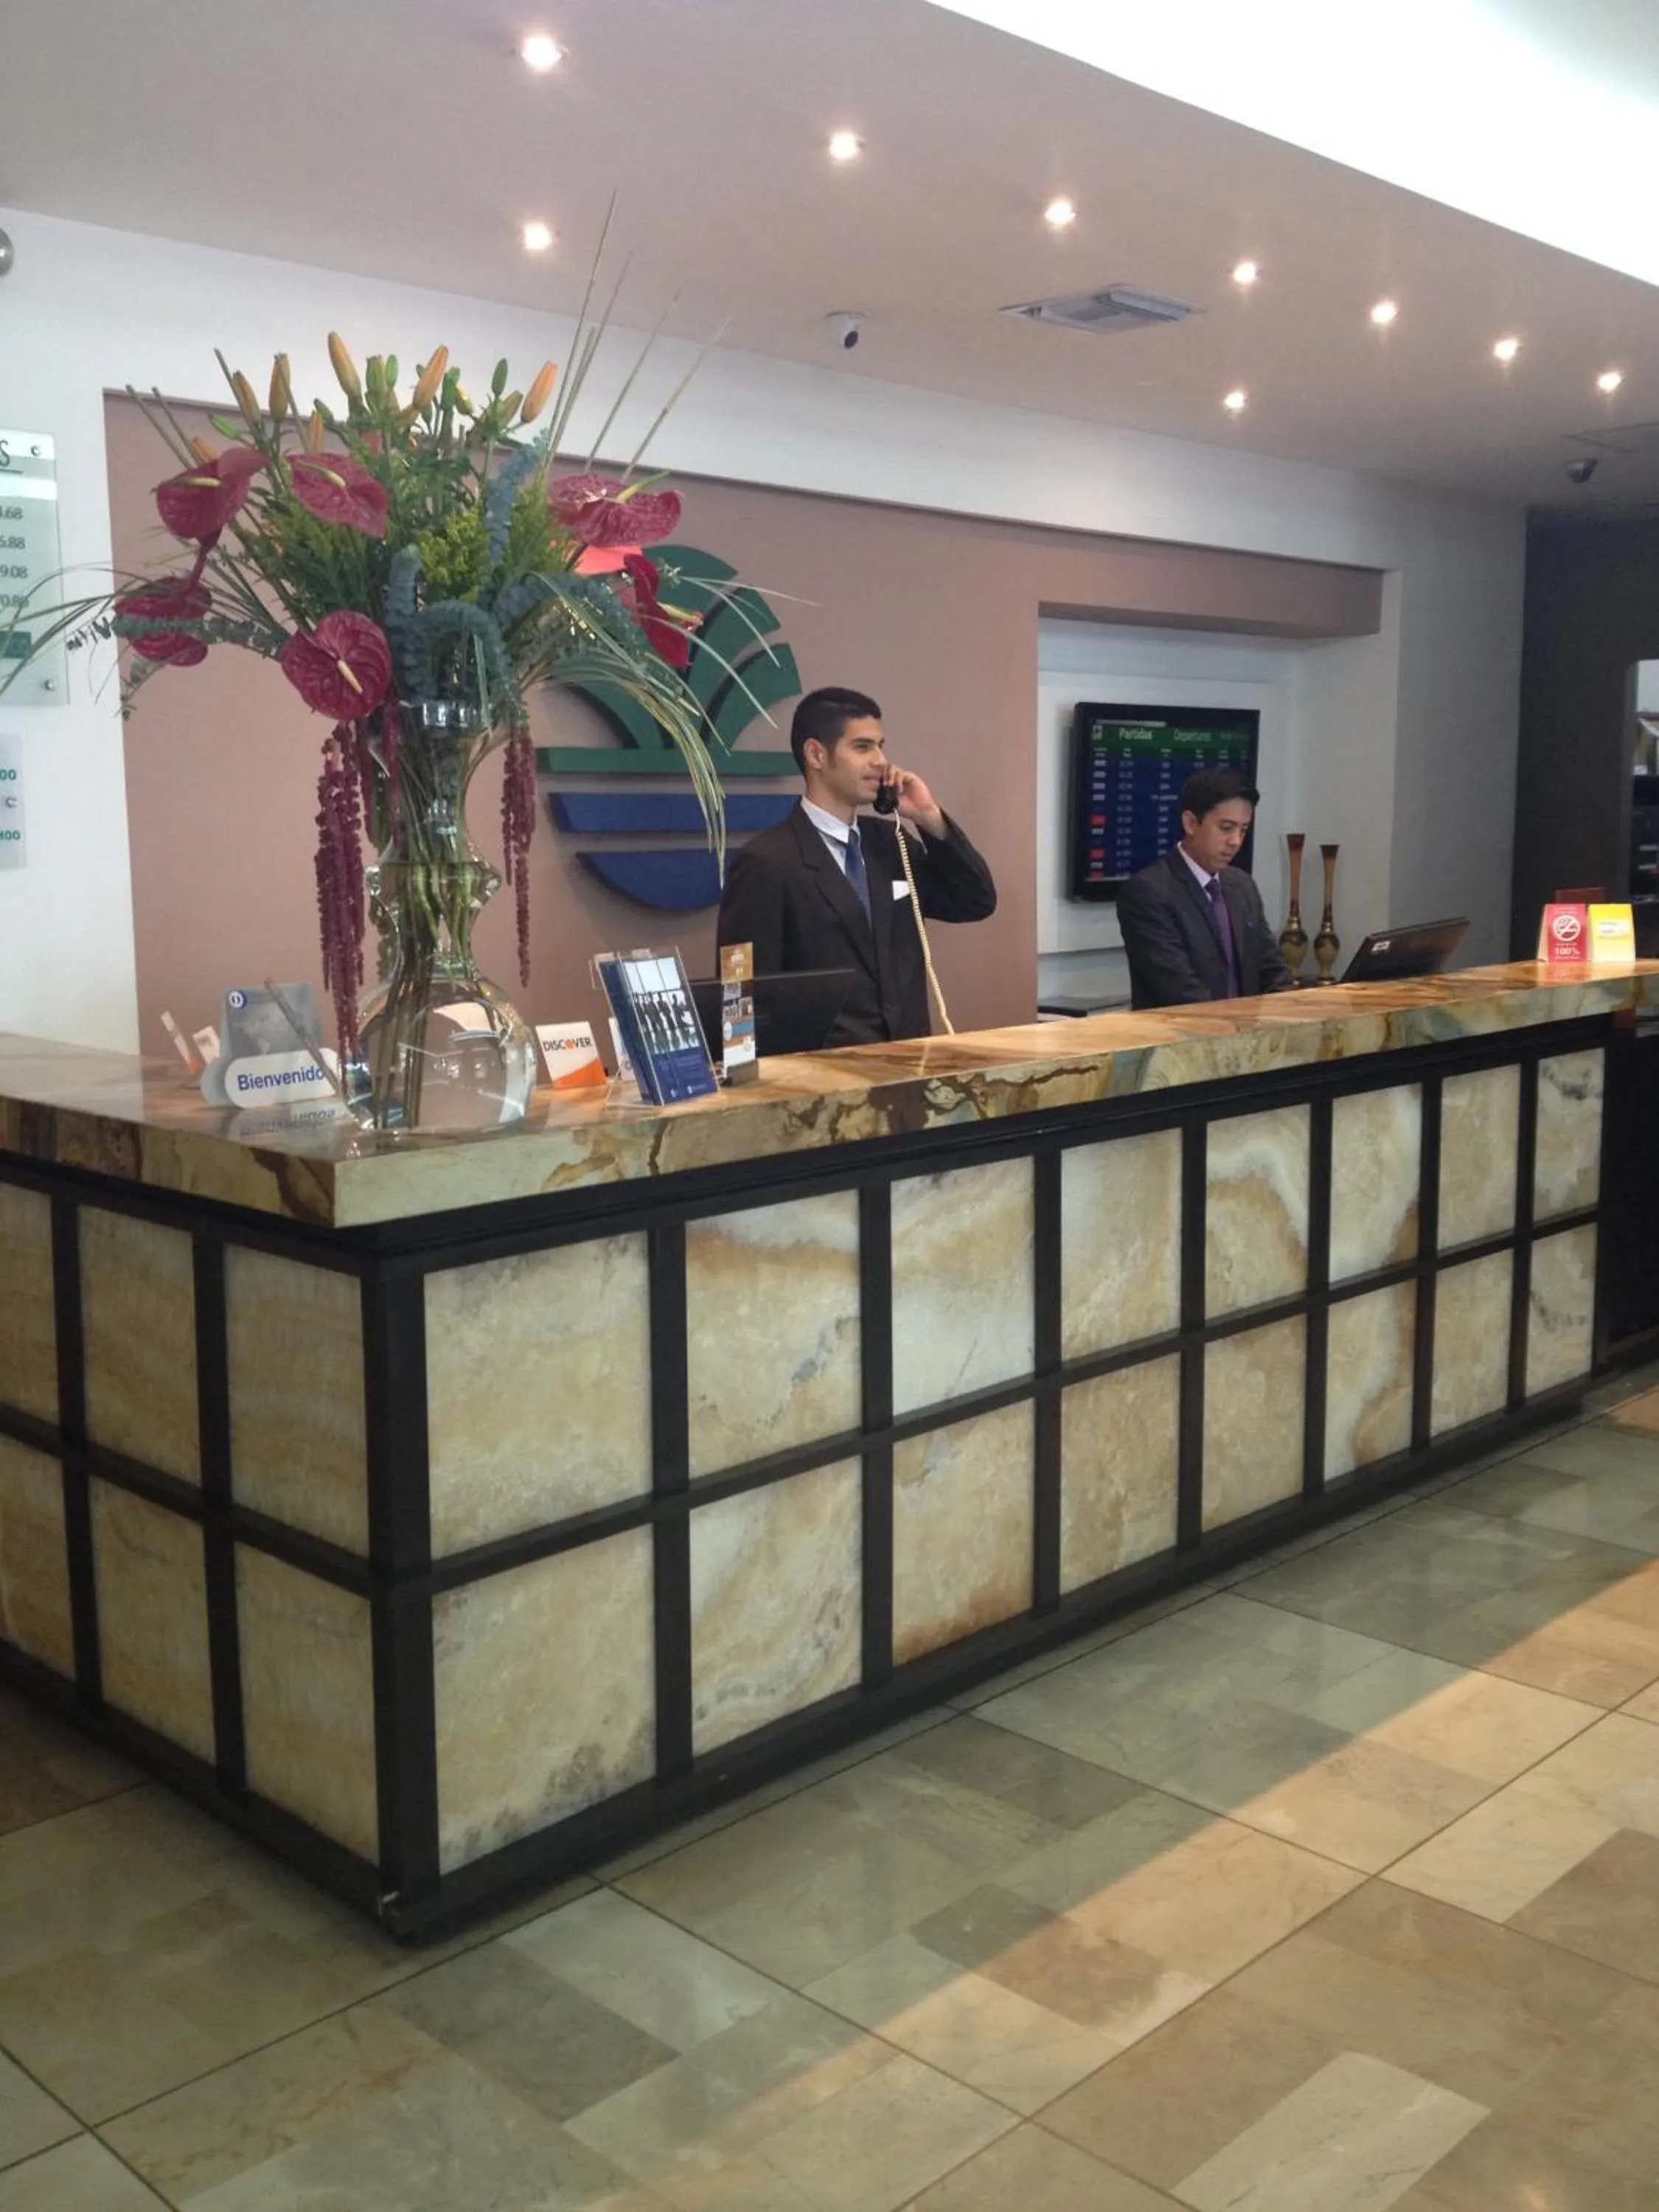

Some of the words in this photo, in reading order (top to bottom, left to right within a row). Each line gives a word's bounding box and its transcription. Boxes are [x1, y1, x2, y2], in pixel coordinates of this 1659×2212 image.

[1119, 727, 1152, 740] Partidas
[543, 1037, 593, 1051] DISCOVER
[237, 1065, 326, 1091] Bienvenido
